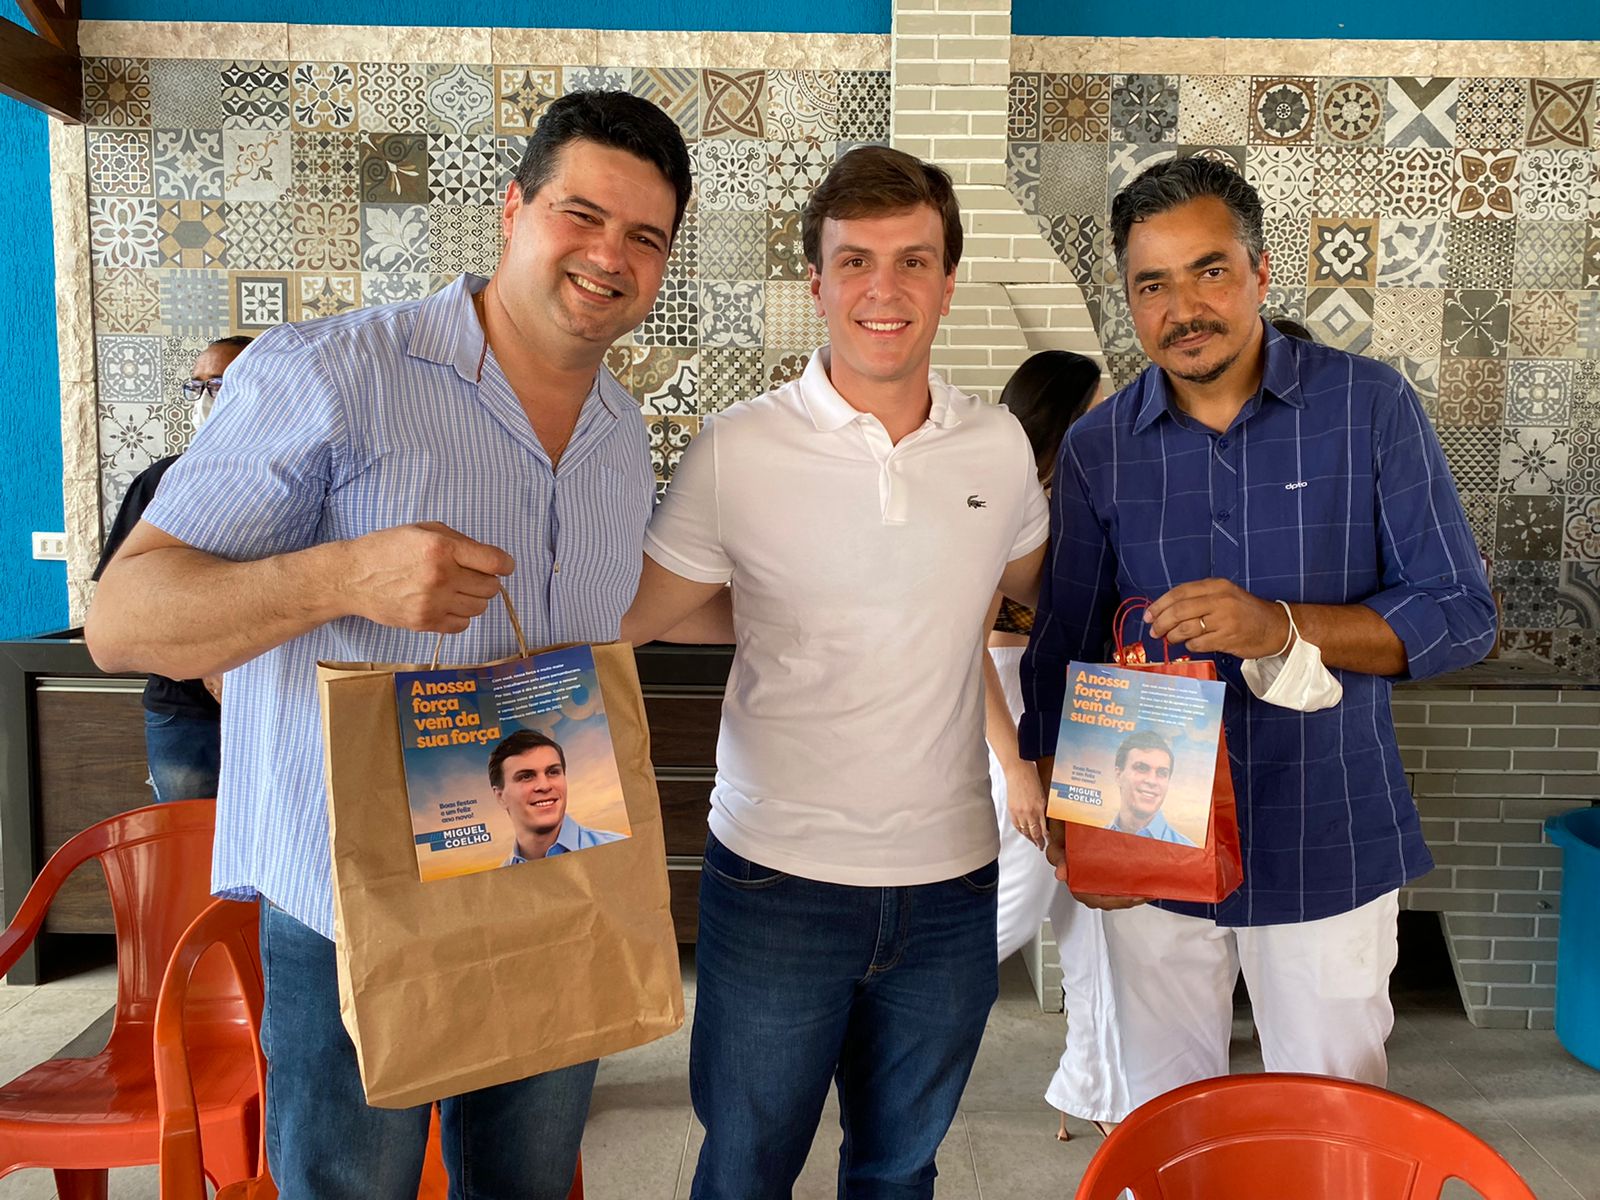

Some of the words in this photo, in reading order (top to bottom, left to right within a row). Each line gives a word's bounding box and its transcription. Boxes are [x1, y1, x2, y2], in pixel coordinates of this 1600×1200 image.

[411, 681, 425, 696] A
[426, 680, 476, 694] nossa
[1076, 671, 1087, 683] A
[1089, 674, 1130, 689] nossa
[1074, 684, 1112, 701] força
[412, 698, 459, 715] força
[1073, 699, 1103, 712] vem
[1104, 702, 1124, 716] da
[414, 716, 453, 731] vem
[455, 711, 480, 727] da
[1070, 712, 1096, 724] sua
[1098, 714, 1136, 732] força
[417, 734, 449, 749] sua
[450, 727, 501, 745] força
[1068, 793, 1102, 805] COELHO
[1069, 786, 1099, 798] MIGUEL
[443, 825, 484, 839] MIGUEL
[445, 834, 490, 848] COELHO
